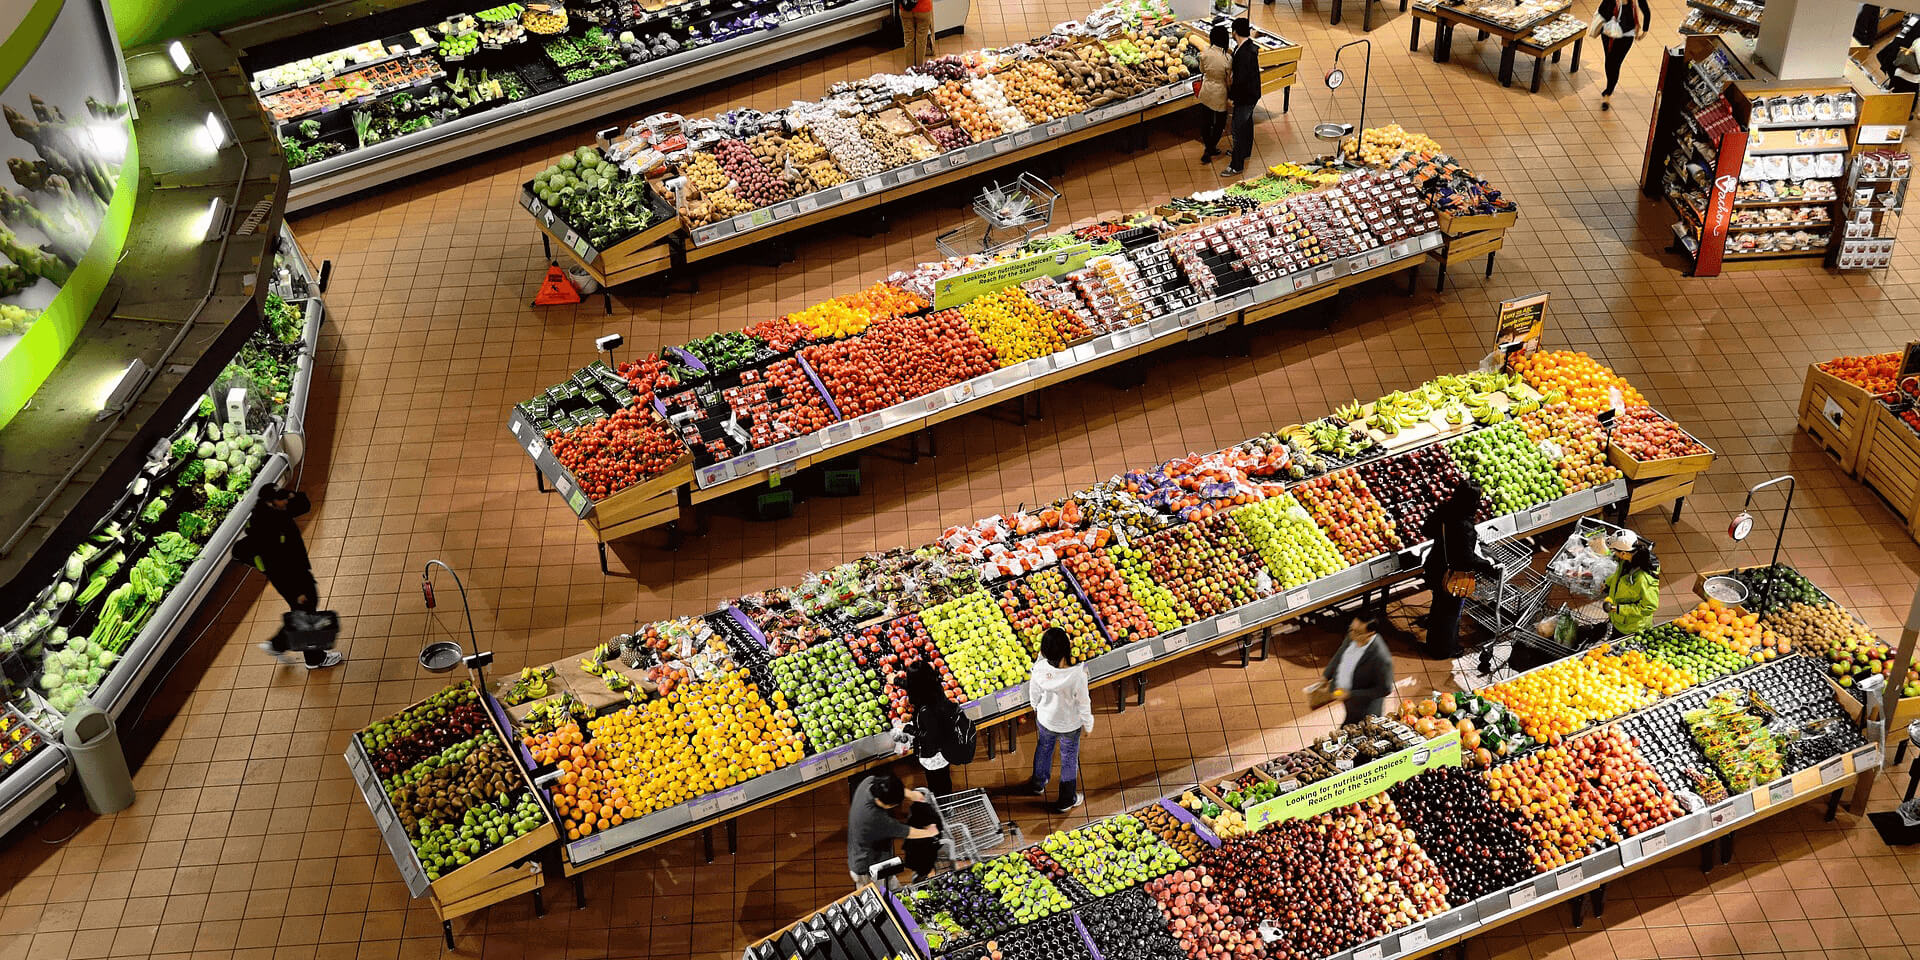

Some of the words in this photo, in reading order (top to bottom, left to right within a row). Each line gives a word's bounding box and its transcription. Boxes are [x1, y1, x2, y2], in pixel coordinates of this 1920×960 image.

[963, 273, 986, 283] Looking
[997, 263, 1027, 274] nutritious
[1027, 256, 1053, 267] choices?
[979, 276, 997, 285] Reach
[1008, 270, 1018, 278] the
[1019, 266, 1037, 274] Stars!
[1286, 790, 1318, 807] Looking
[1319, 785, 1331, 794] for
[1332, 771, 1373, 789] nutritious
[1374, 755, 1408, 773] choices?
[1308, 793, 1333, 807] Reach
[1335, 788, 1347, 796] for
[1348, 783, 1362, 791] the
[1363, 771, 1388, 786] Stars!
